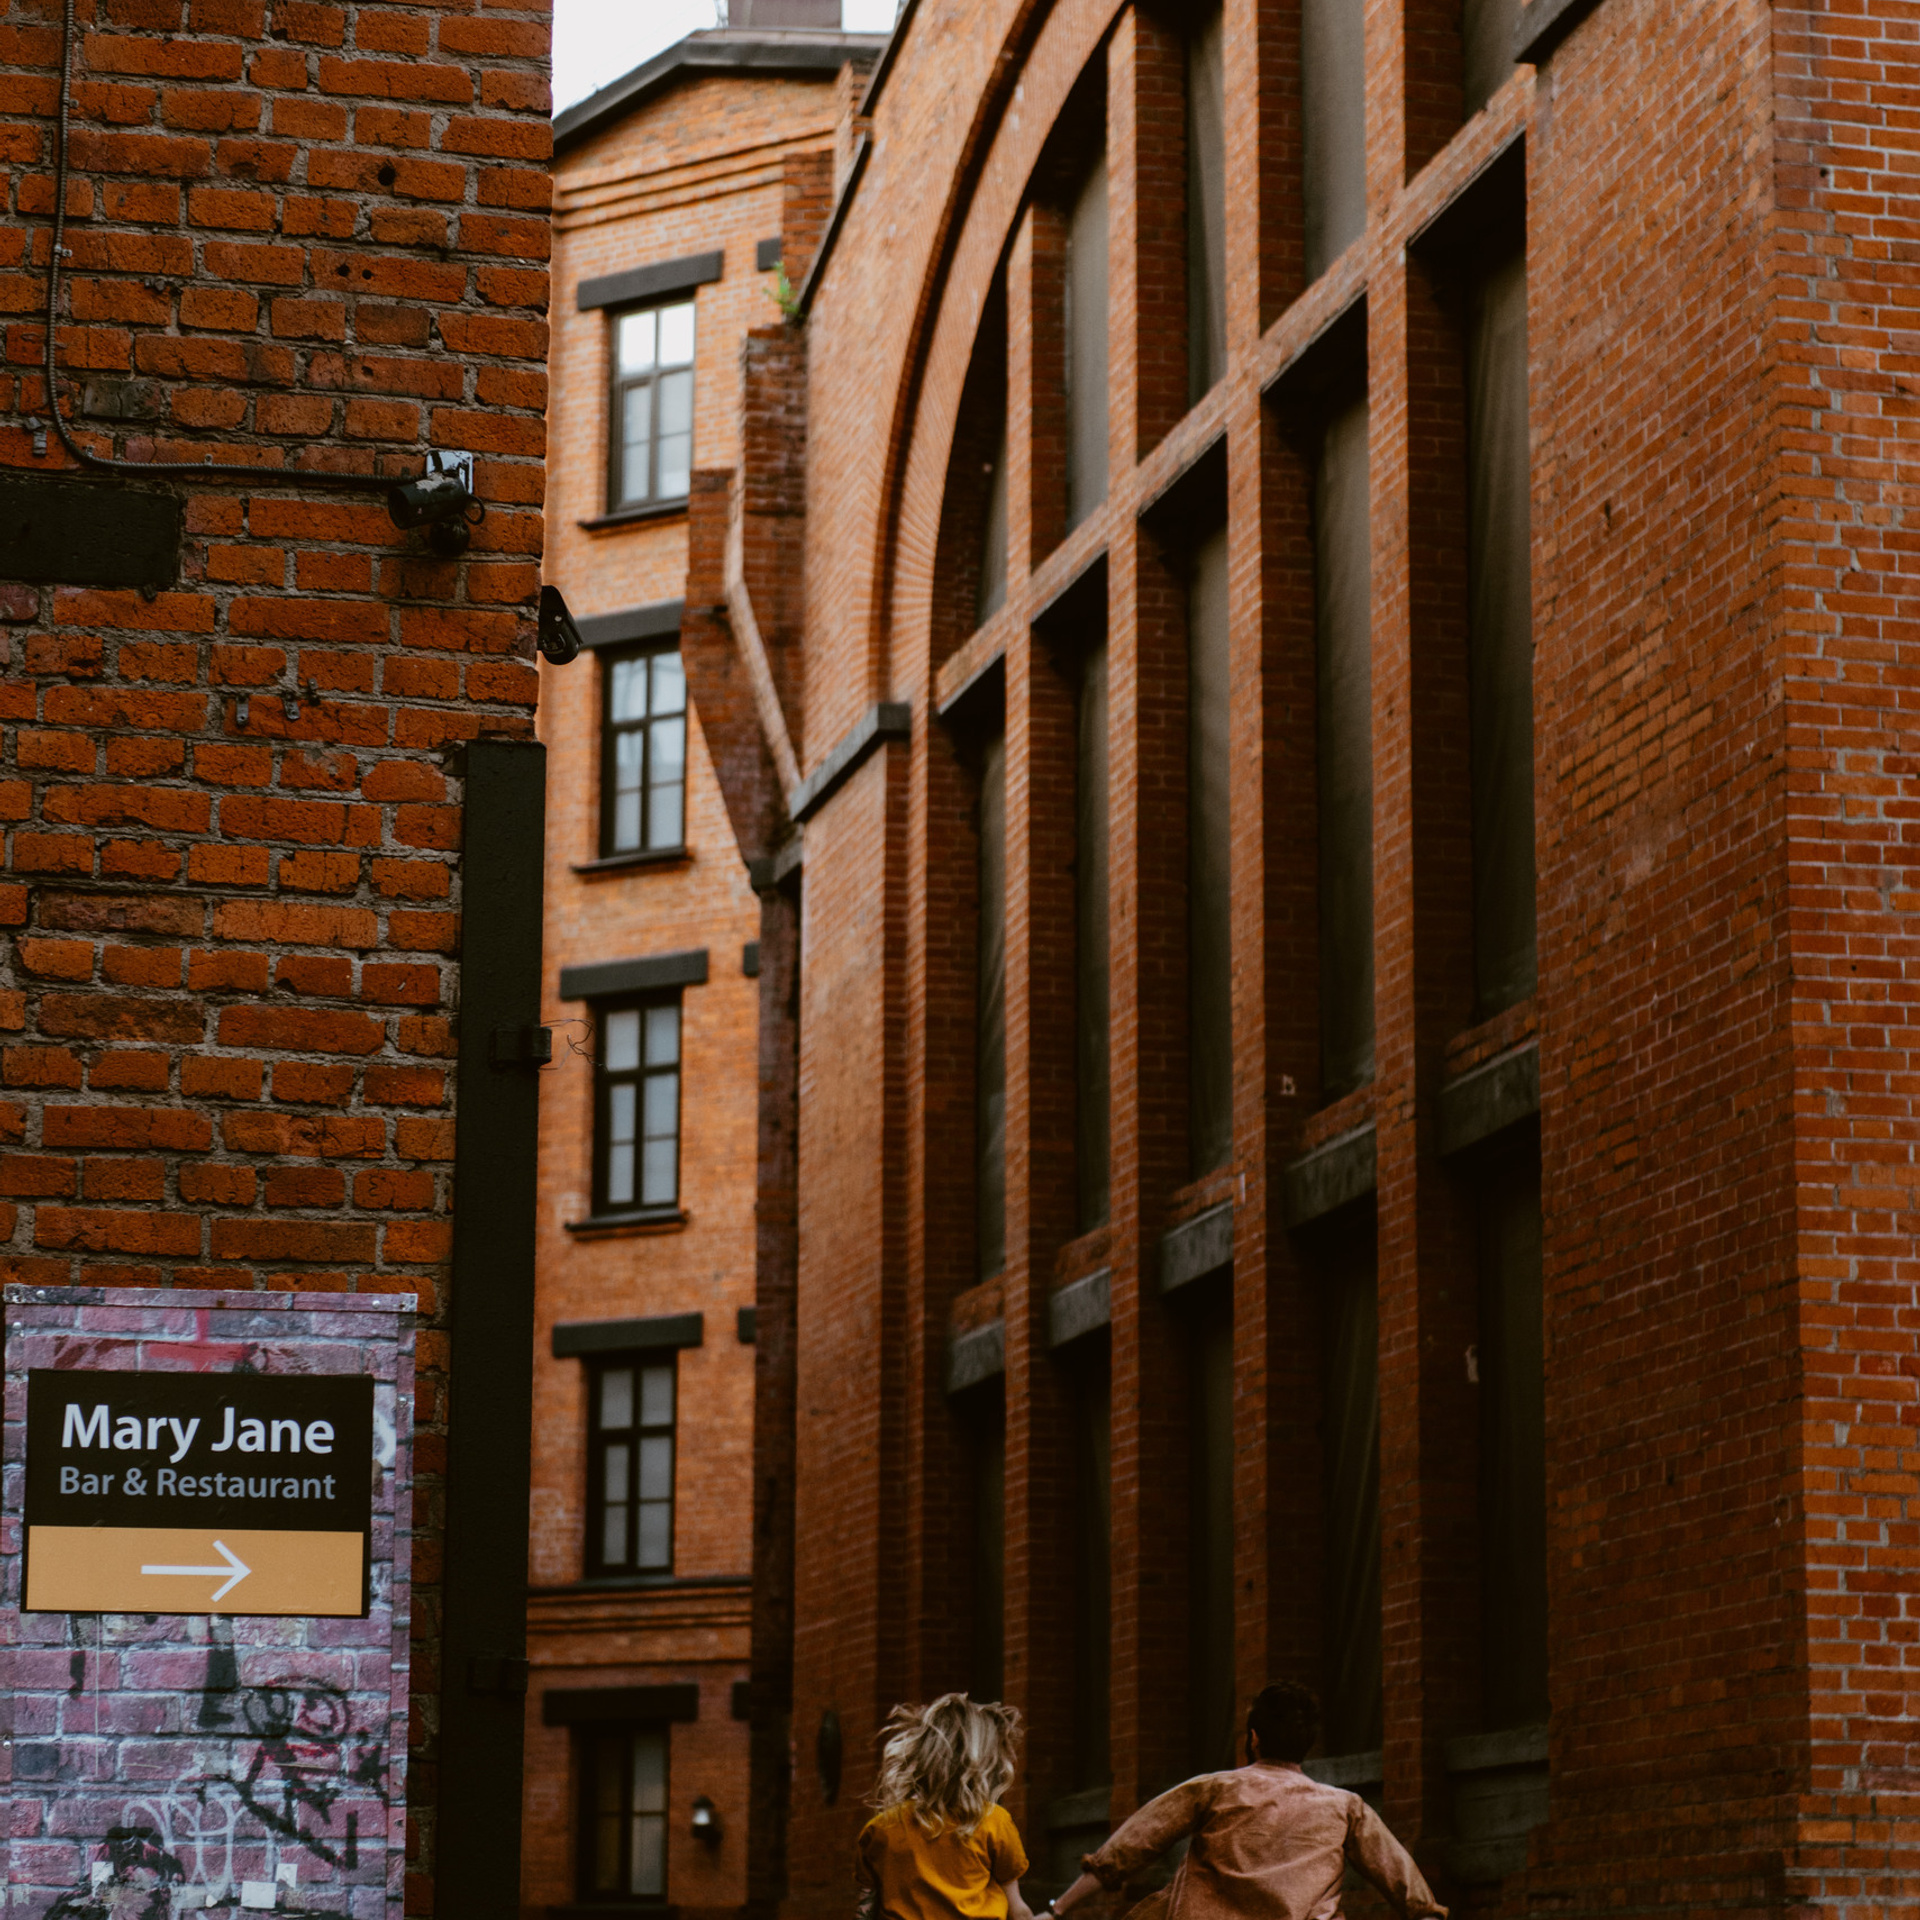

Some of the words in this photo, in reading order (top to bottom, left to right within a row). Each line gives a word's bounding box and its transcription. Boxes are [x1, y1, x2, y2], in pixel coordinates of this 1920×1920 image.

[61, 1403, 200, 1463] Mary
[211, 1406, 335, 1453] Jane
[60, 1466, 114, 1495] Bar
[122, 1468, 148, 1496] &
[157, 1468, 336, 1499] Restaurant
